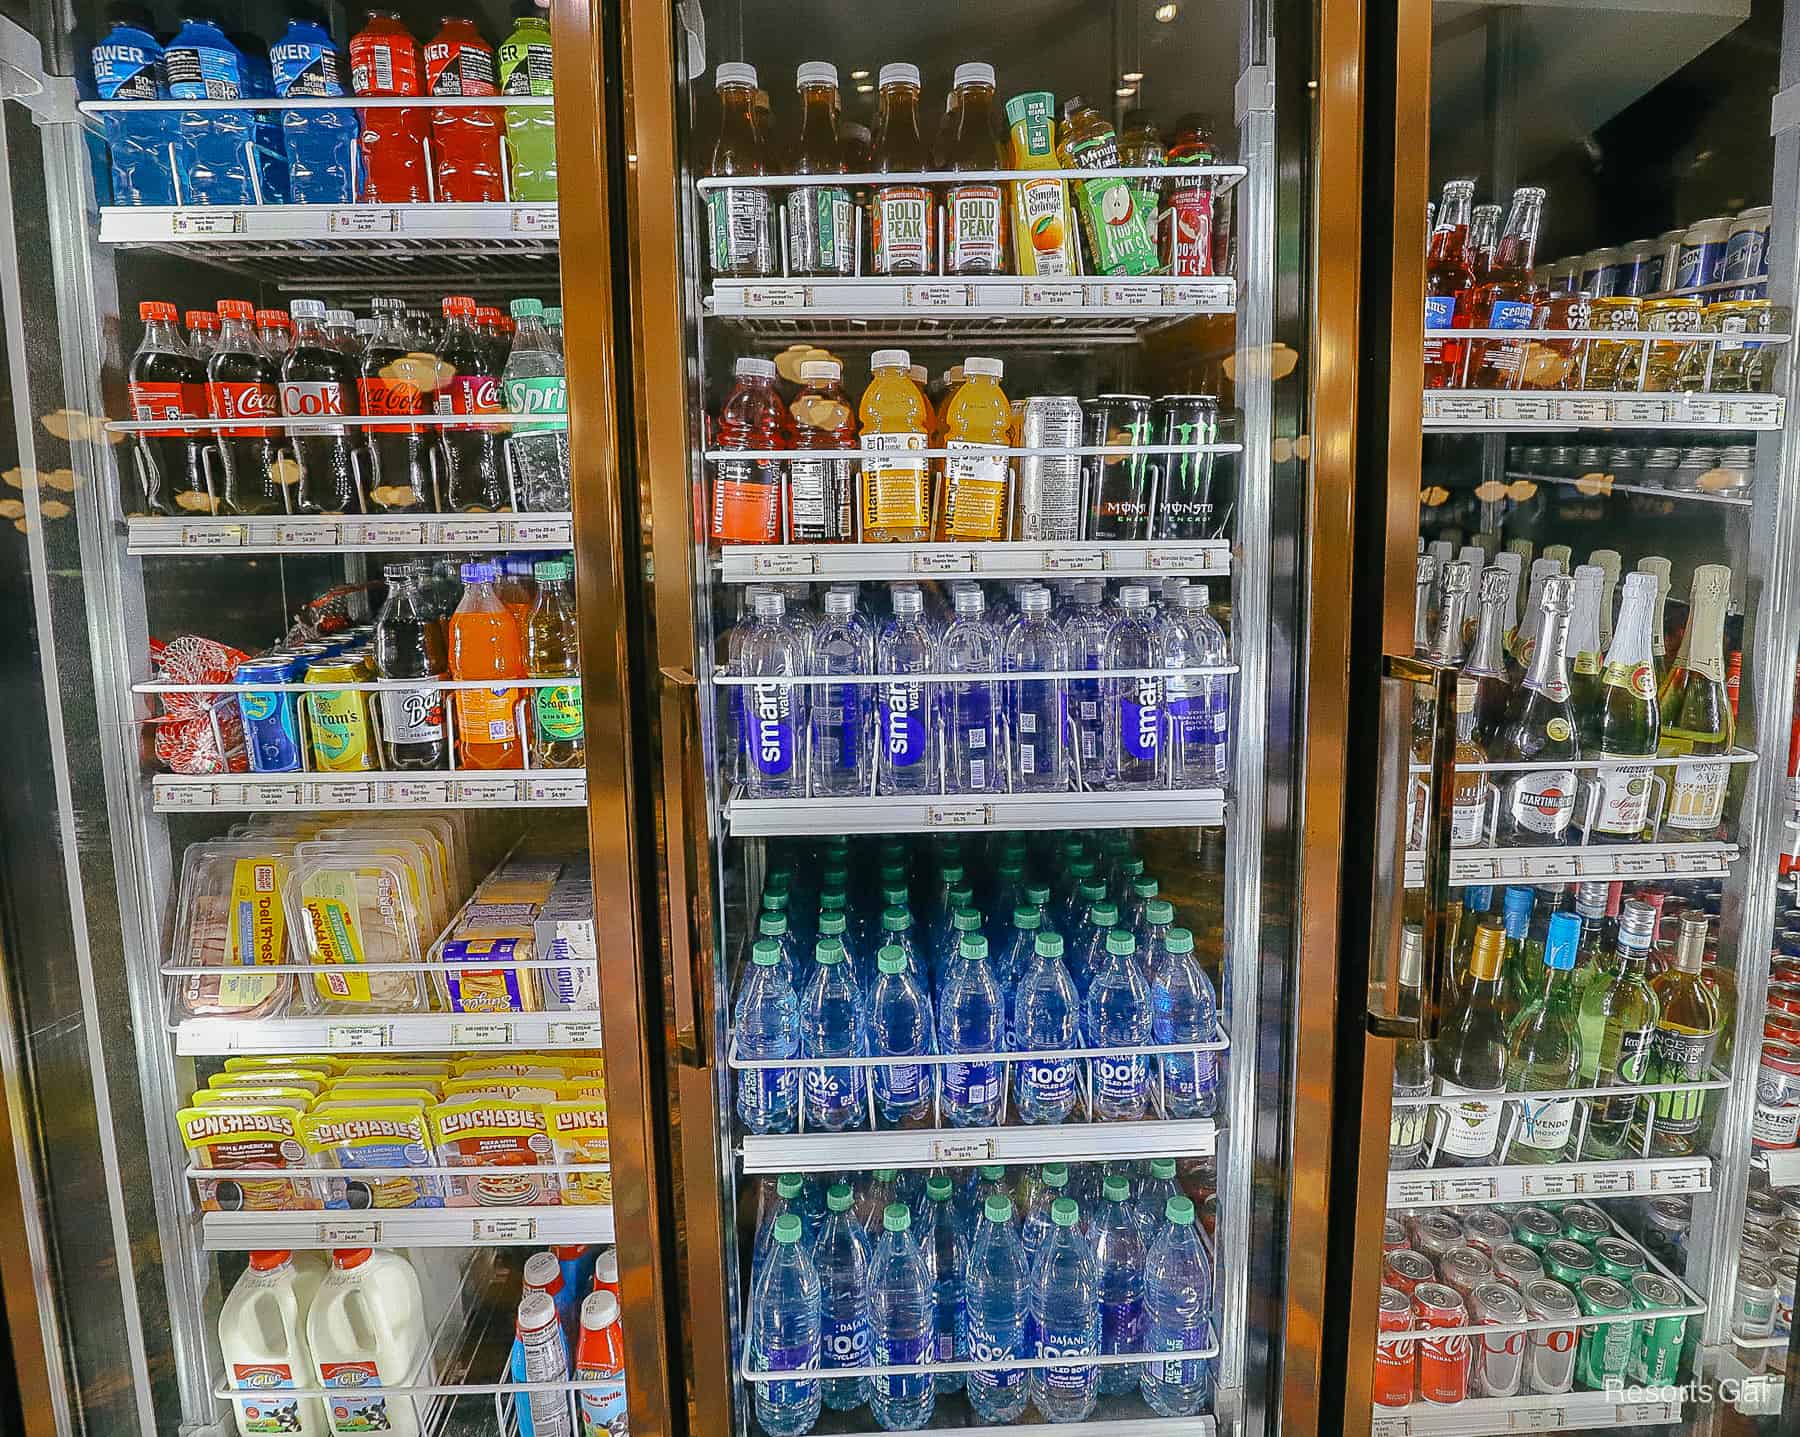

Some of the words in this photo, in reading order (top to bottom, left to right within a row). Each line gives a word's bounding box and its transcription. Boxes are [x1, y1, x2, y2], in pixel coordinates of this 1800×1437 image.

[93, 46, 143, 64] OWER
[1080, 144, 1118, 165] Minute
[1028, 188, 1060, 204] Simply
[888, 201, 921, 220] GOLD
[960, 201, 994, 220] GOLD
[1029, 200, 1062, 216] Orange
[888, 220, 921, 238] PEAK
[960, 220, 994, 238] PEAK
[237, 386, 277, 416] Coca
[510, 380, 567, 414] Spri
[1440, 594, 1452, 634] ASTI
[1556, 614, 1569, 658] ASTI
[755, 683, 781, 762] smart
[260, 896, 273, 924] Deli
[552, 937, 576, 1004] PHILADPHIA
[1658, 1046, 1699, 1064] VINE
[186, 1115, 294, 1140] LUNCHABLES
[440, 1109, 547, 1134] LUNCHABLES
[556, 1111, 608, 1131] LUNCH
[319, 1119, 423, 1144] LUNCHABLES
[1050, 1335, 1086, 1346] DASANI
[600, 1391, 622, 1401] milk
